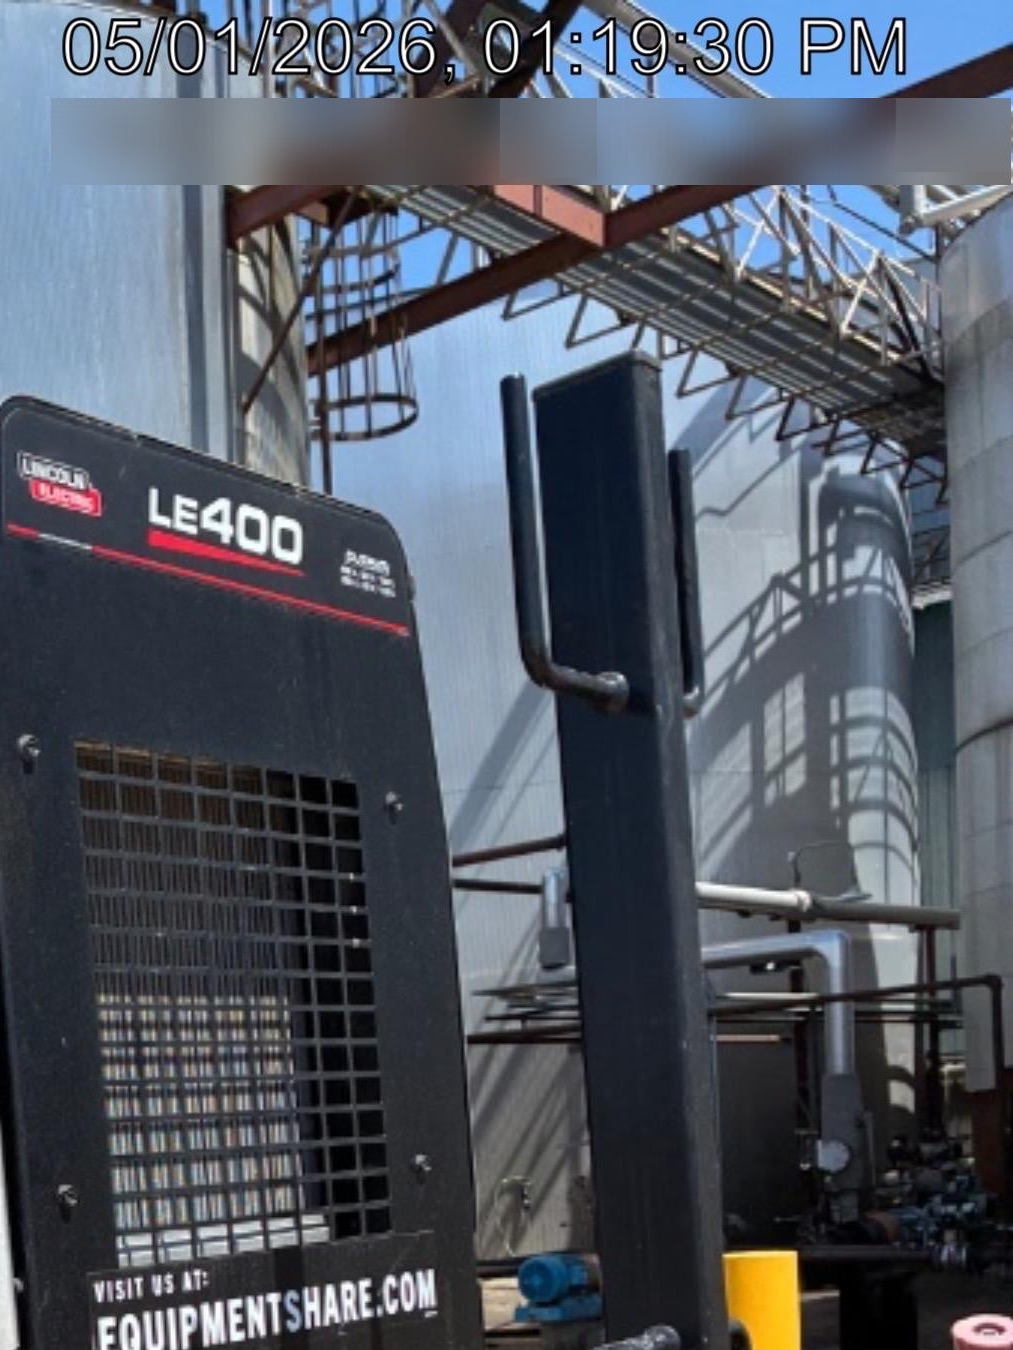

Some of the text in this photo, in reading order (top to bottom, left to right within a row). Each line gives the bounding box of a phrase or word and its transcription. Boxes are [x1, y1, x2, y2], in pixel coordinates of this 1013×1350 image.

[147, 487, 304, 566] LE400
[93, 1268, 209, 1303] VISIT US AT:
